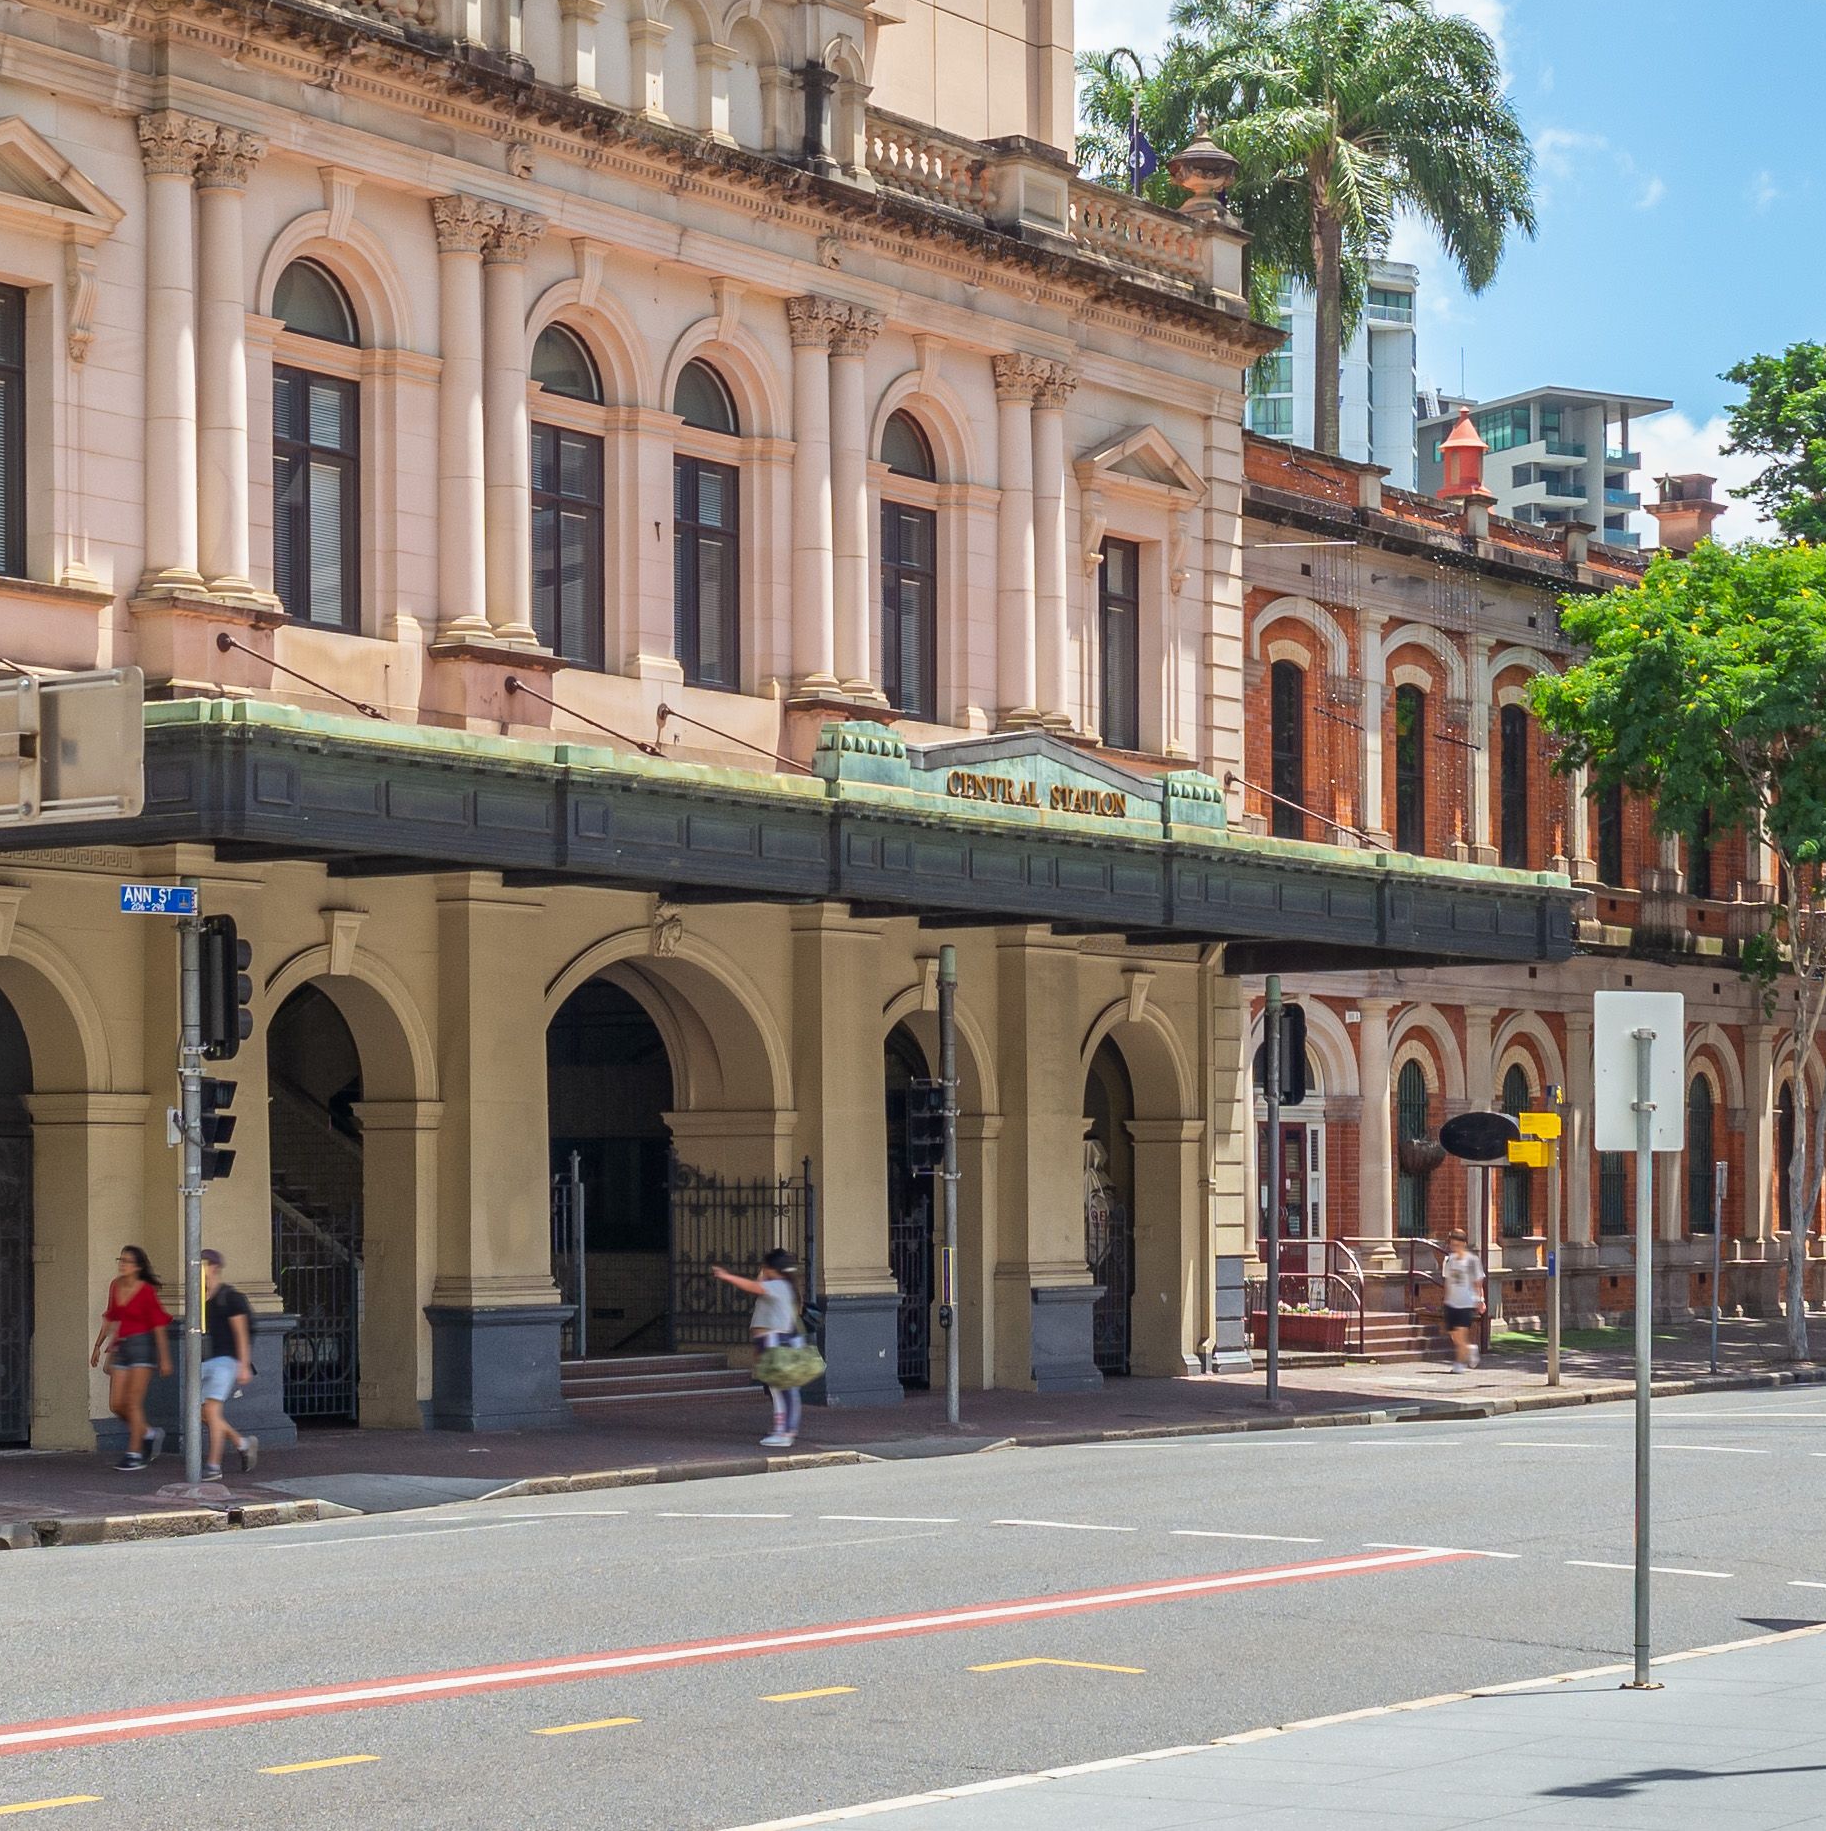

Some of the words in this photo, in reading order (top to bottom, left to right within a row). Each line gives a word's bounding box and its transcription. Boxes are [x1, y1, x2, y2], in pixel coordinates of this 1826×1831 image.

[947, 770, 1041, 808] CENTRAL
[1050, 784, 1127, 817] STATION
[124, 887, 152, 902] ANN
[158, 888, 173, 903] ST
